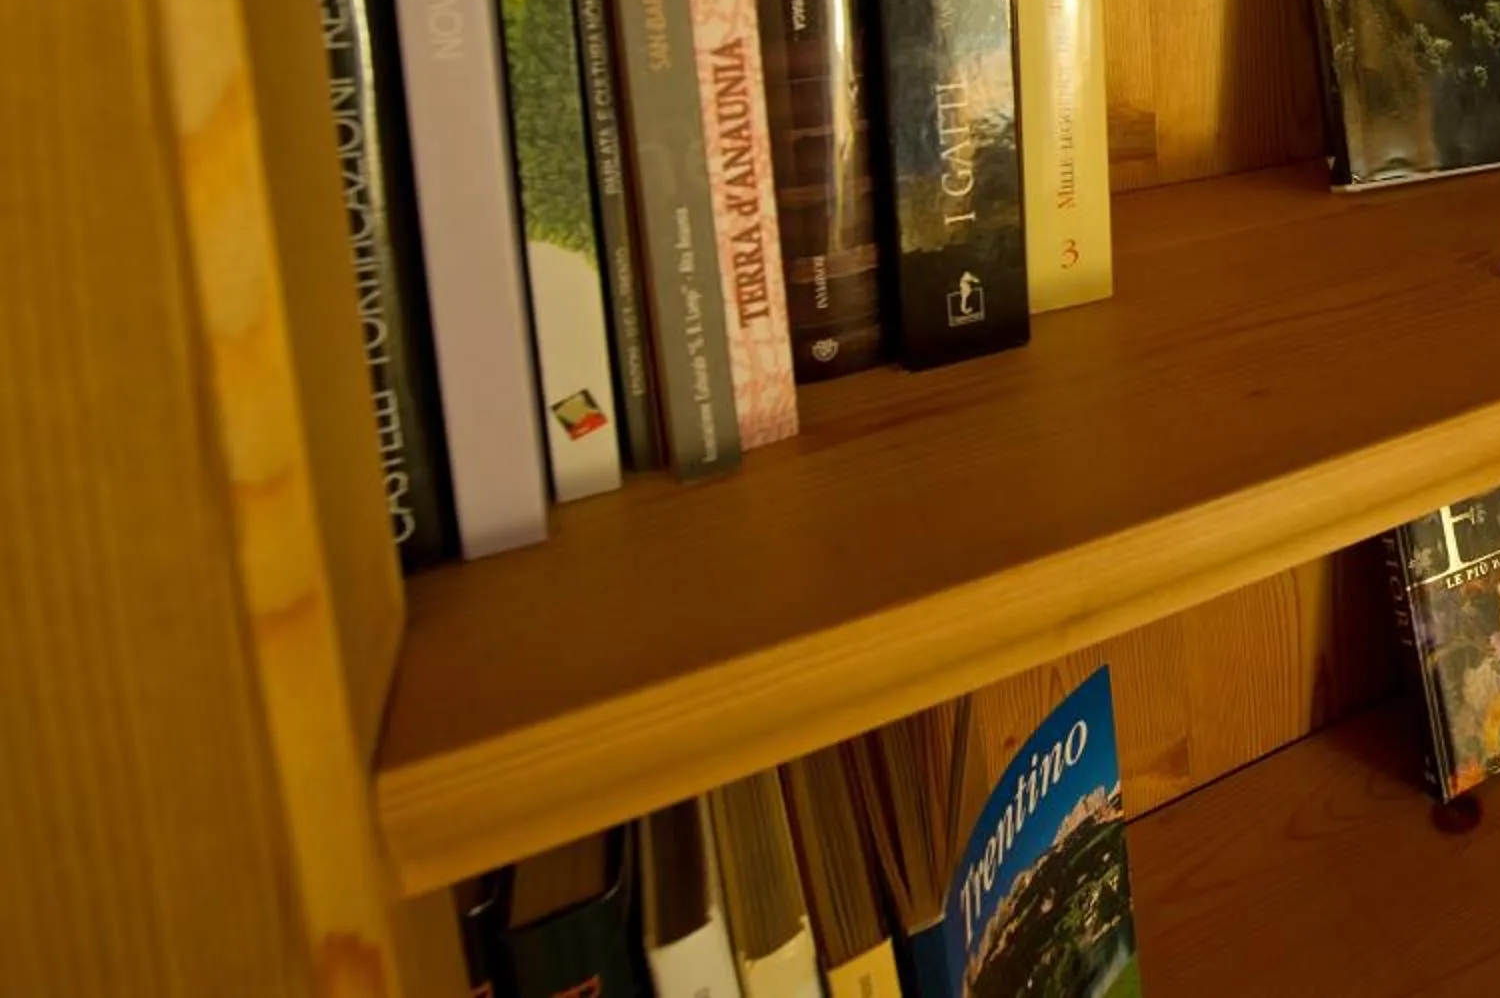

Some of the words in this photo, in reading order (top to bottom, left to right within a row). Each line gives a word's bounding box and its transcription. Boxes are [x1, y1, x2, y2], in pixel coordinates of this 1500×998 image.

[588, 31, 611, 106] CULTURA
[646, 33, 672, 72] SAN
[711, 36, 760, 215] d'ANAUNIA
[936, 77, 977, 198] GATTI
[598, 126, 622, 195] PARLATA
[1057, 153, 1078, 212] MILLE
[943, 208, 978, 227] I
[731, 220, 773, 331] TERRA
[1058, 237, 1083, 272] 3
[1445, 575, 1464, 590] LE
[959, 718, 1089, 948] Trentino
